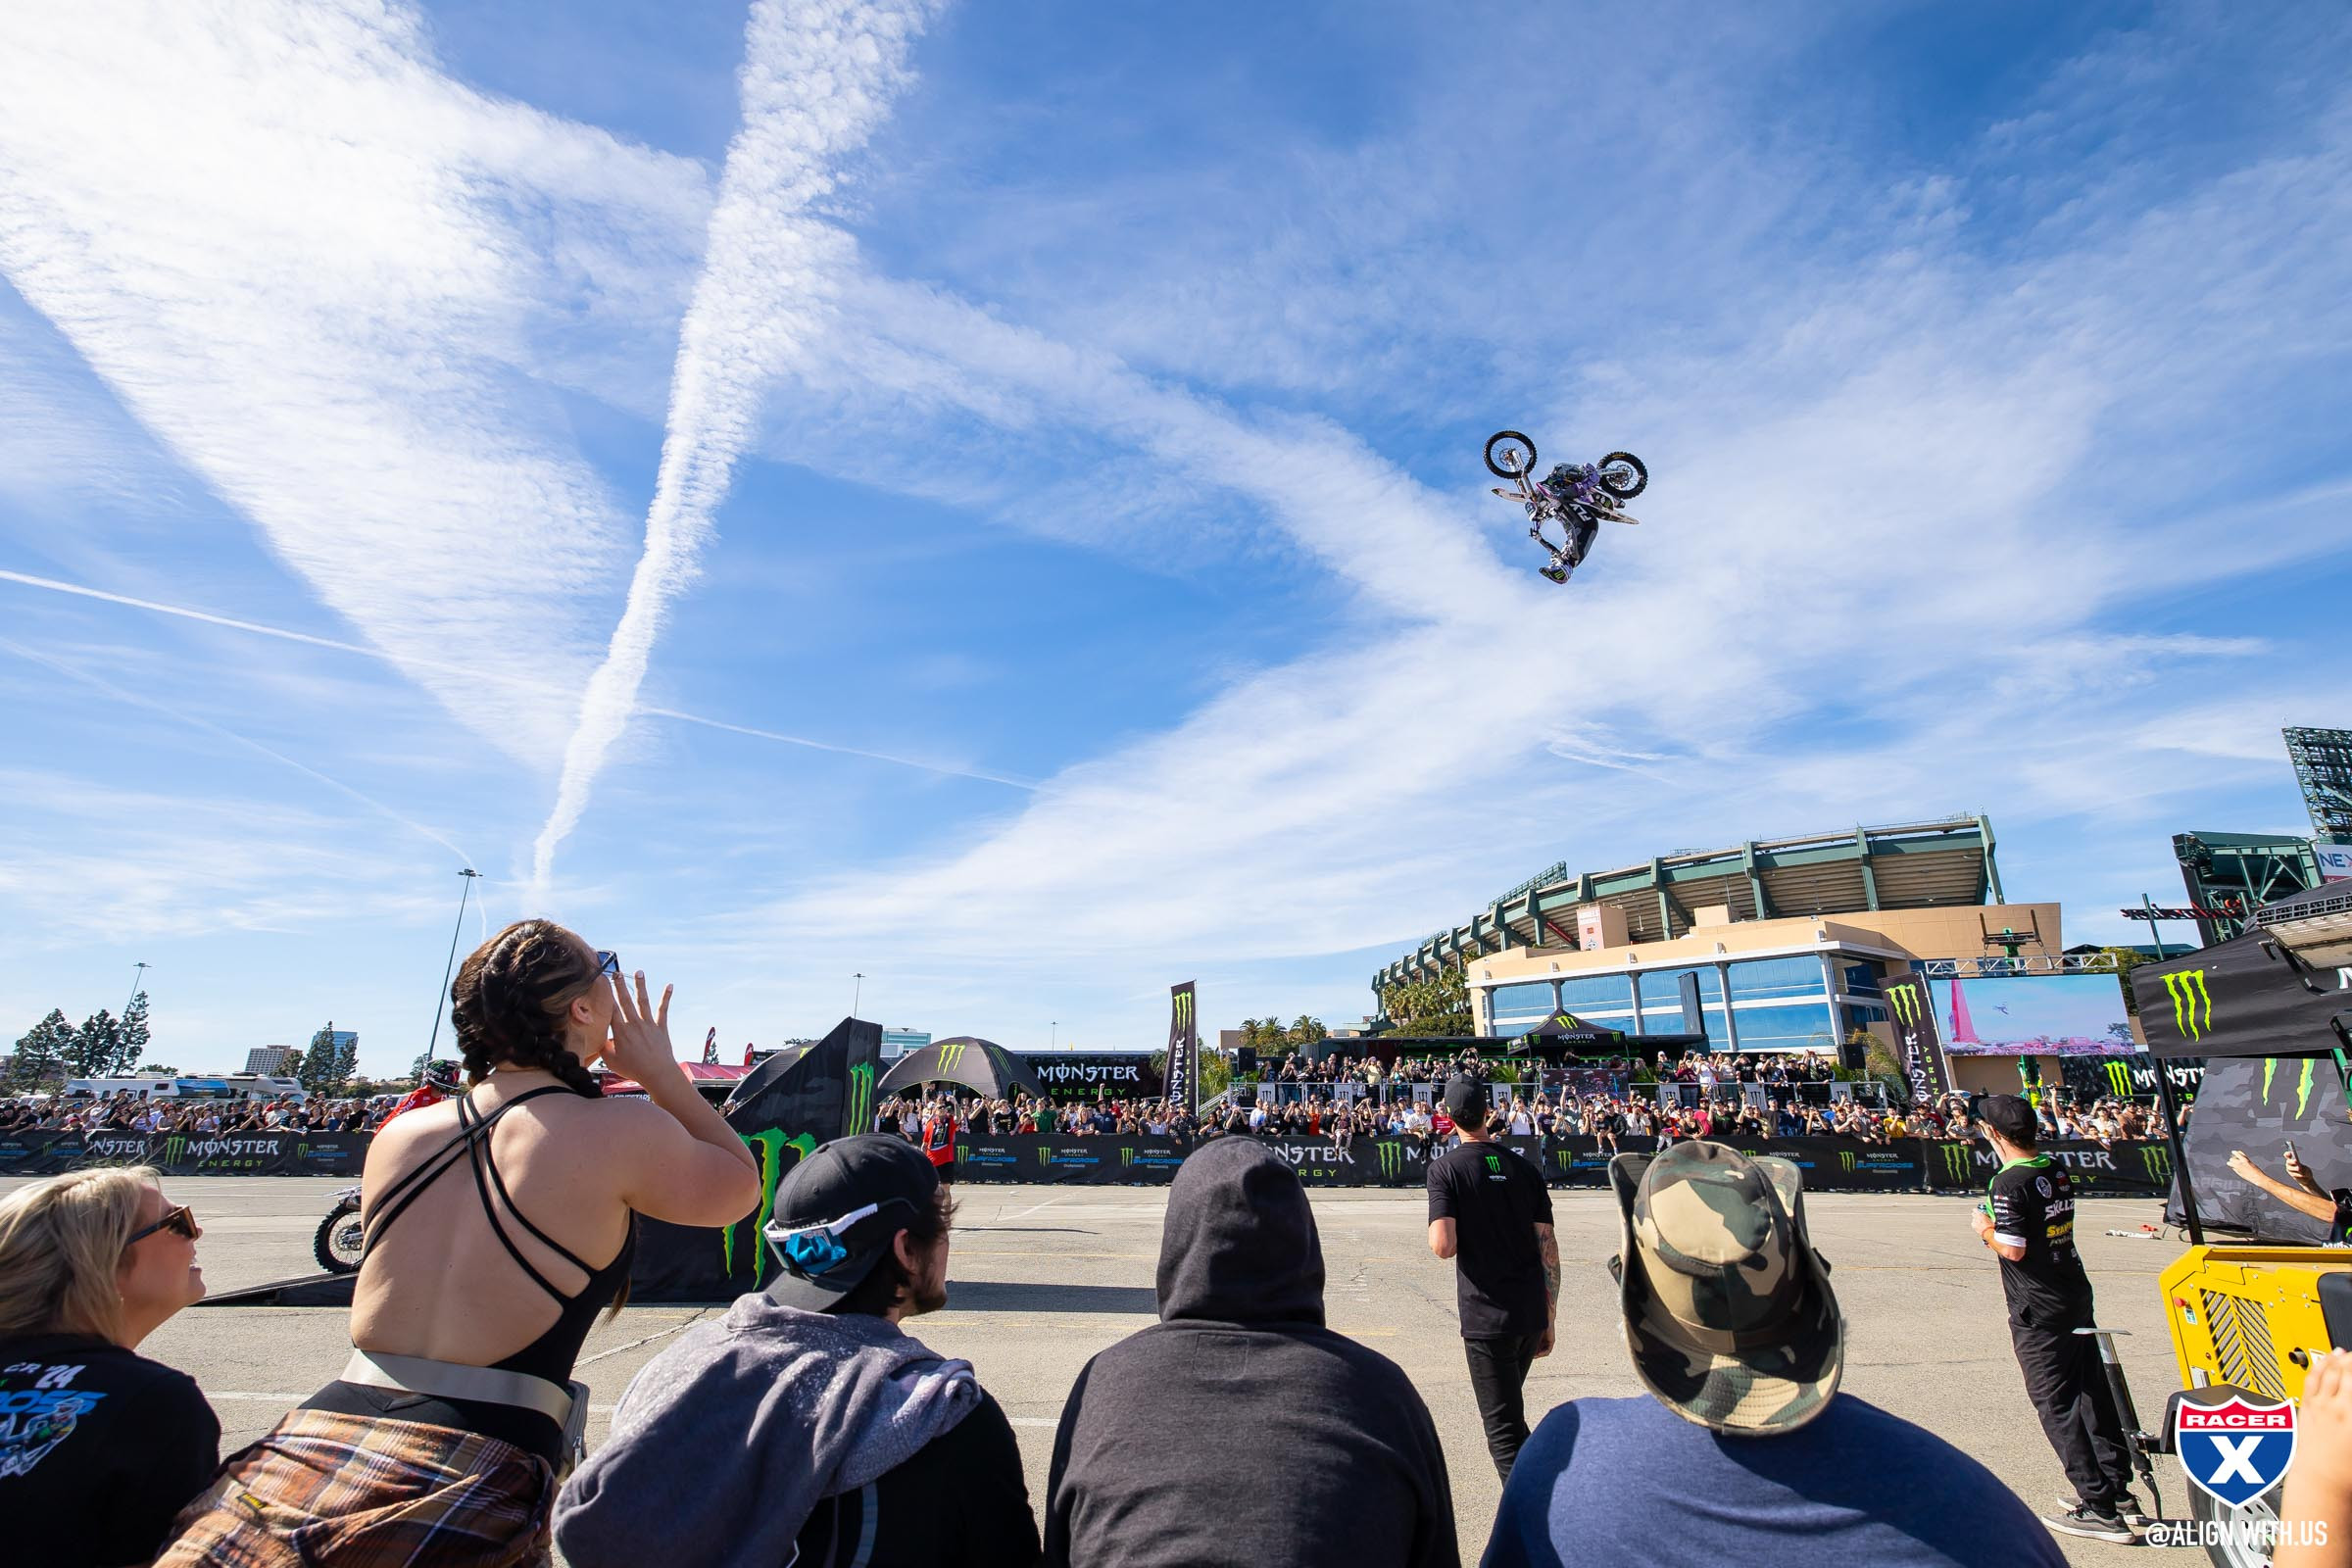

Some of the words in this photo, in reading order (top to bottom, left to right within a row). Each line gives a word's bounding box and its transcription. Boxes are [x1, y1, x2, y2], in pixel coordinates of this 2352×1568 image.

[1557, 1032, 1596, 1041] MONSTER
[1037, 1062, 1140, 1083] MONSTER
[1904, 1032, 1932, 1102] ONSTER
[93, 1137, 145, 1155] NSTER
[186, 1137, 279, 1157] MONSTER
[1262, 1142, 1355, 1164] NSTER
[198, 1159, 264, 1168] ENERGY
[1975, 1151, 2117, 1171] MTER
[1298, 1168, 1337, 1177] RGY
